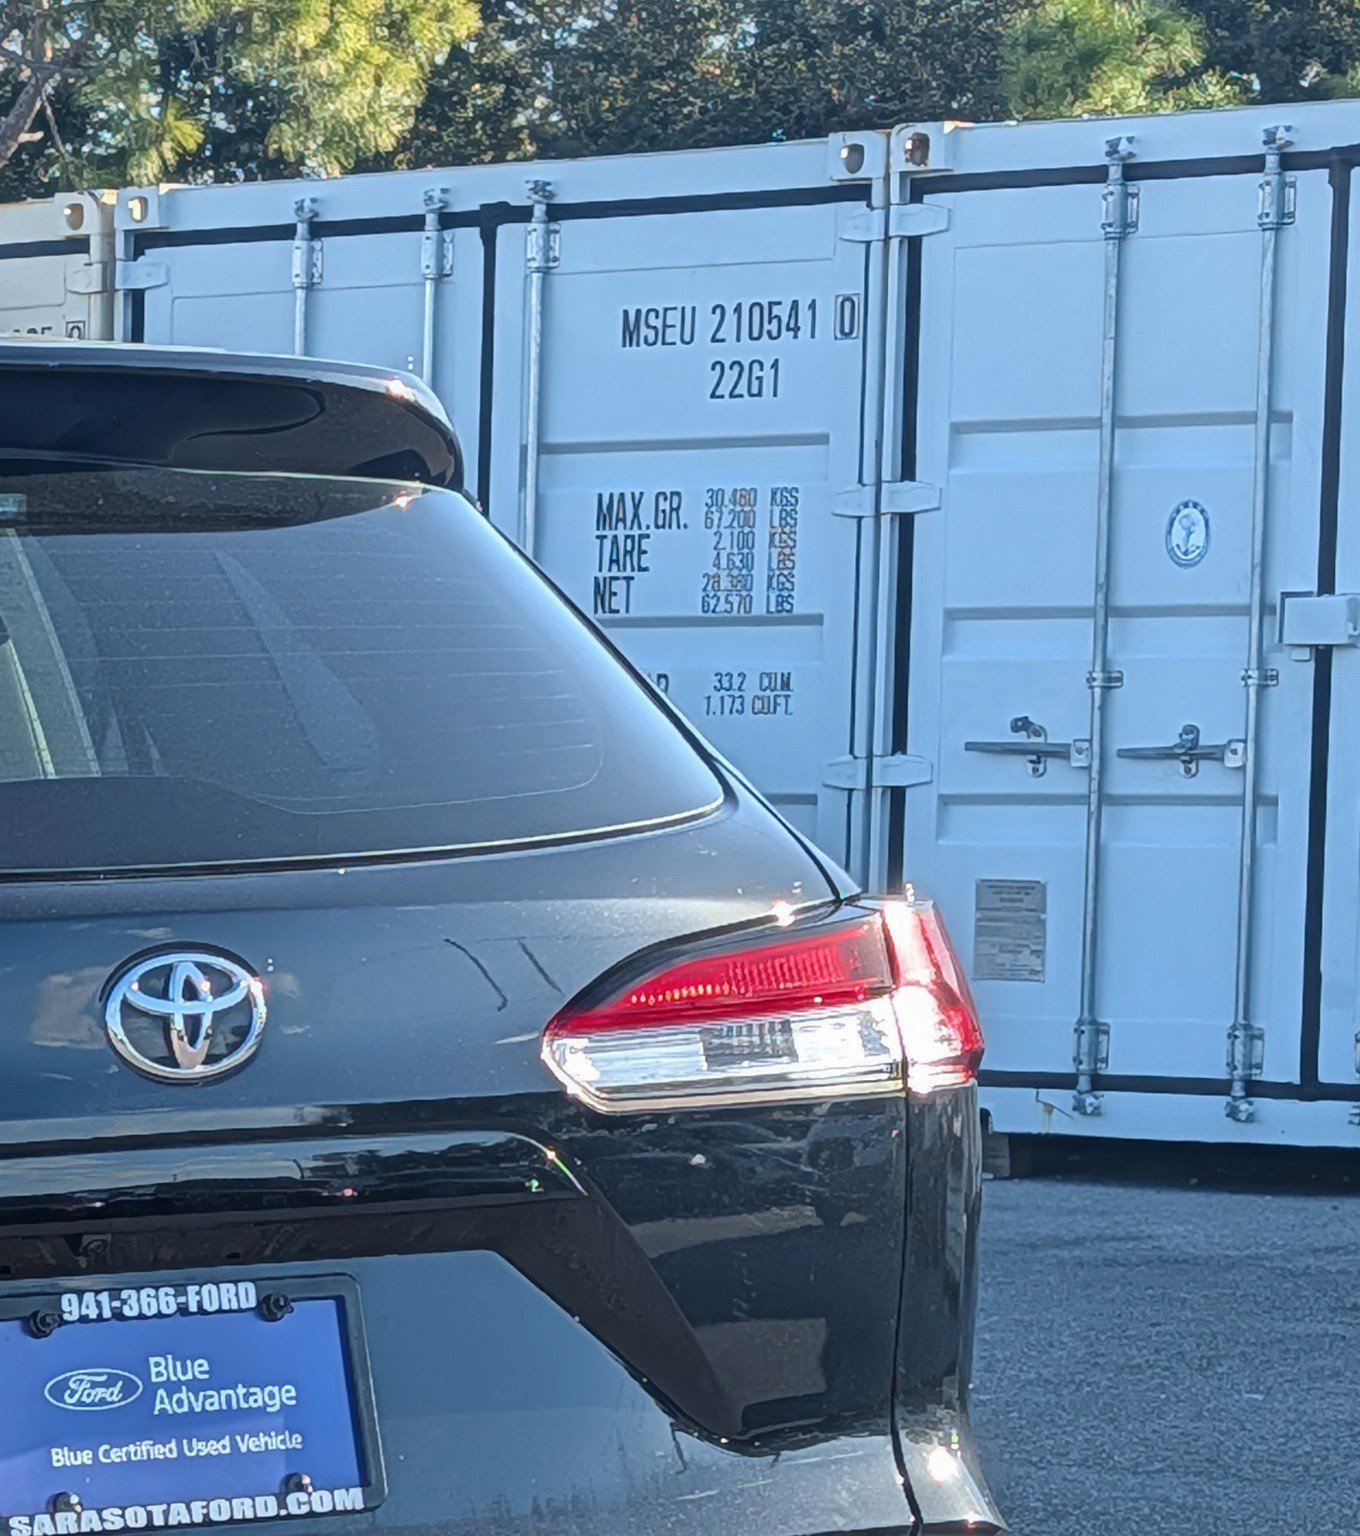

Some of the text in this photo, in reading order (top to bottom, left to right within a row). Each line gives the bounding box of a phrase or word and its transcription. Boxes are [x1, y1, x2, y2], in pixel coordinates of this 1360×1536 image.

[621, 295, 857, 349] MSEU 210541 0
[709, 357, 780, 400] 22G1
[595, 490, 689, 531] MAX.GR.
[770, 486, 800, 507] KGS
[769, 507, 799, 529] LBS
[595, 533, 651, 573] TARE
[768, 529, 798, 551] KGS
[712, 550, 796, 572] 4.630 LBS
[593, 575, 635, 615] NET
[766, 572, 796, 593] KGS
[701, 593, 795, 615] 62.570 LBS
[713, 671, 747, 693] 33.2
[704, 694, 745, 716] 1.173
[60, 1281, 258, 1323] 941-366-FORD
[148, 1354, 211, 1384] Blue
[62, 1373, 125, 1405] Ford
[153, 1382, 298, 1416] Advantage
[51, 1430, 304, 1468] Blue Certified Used Vehicle
